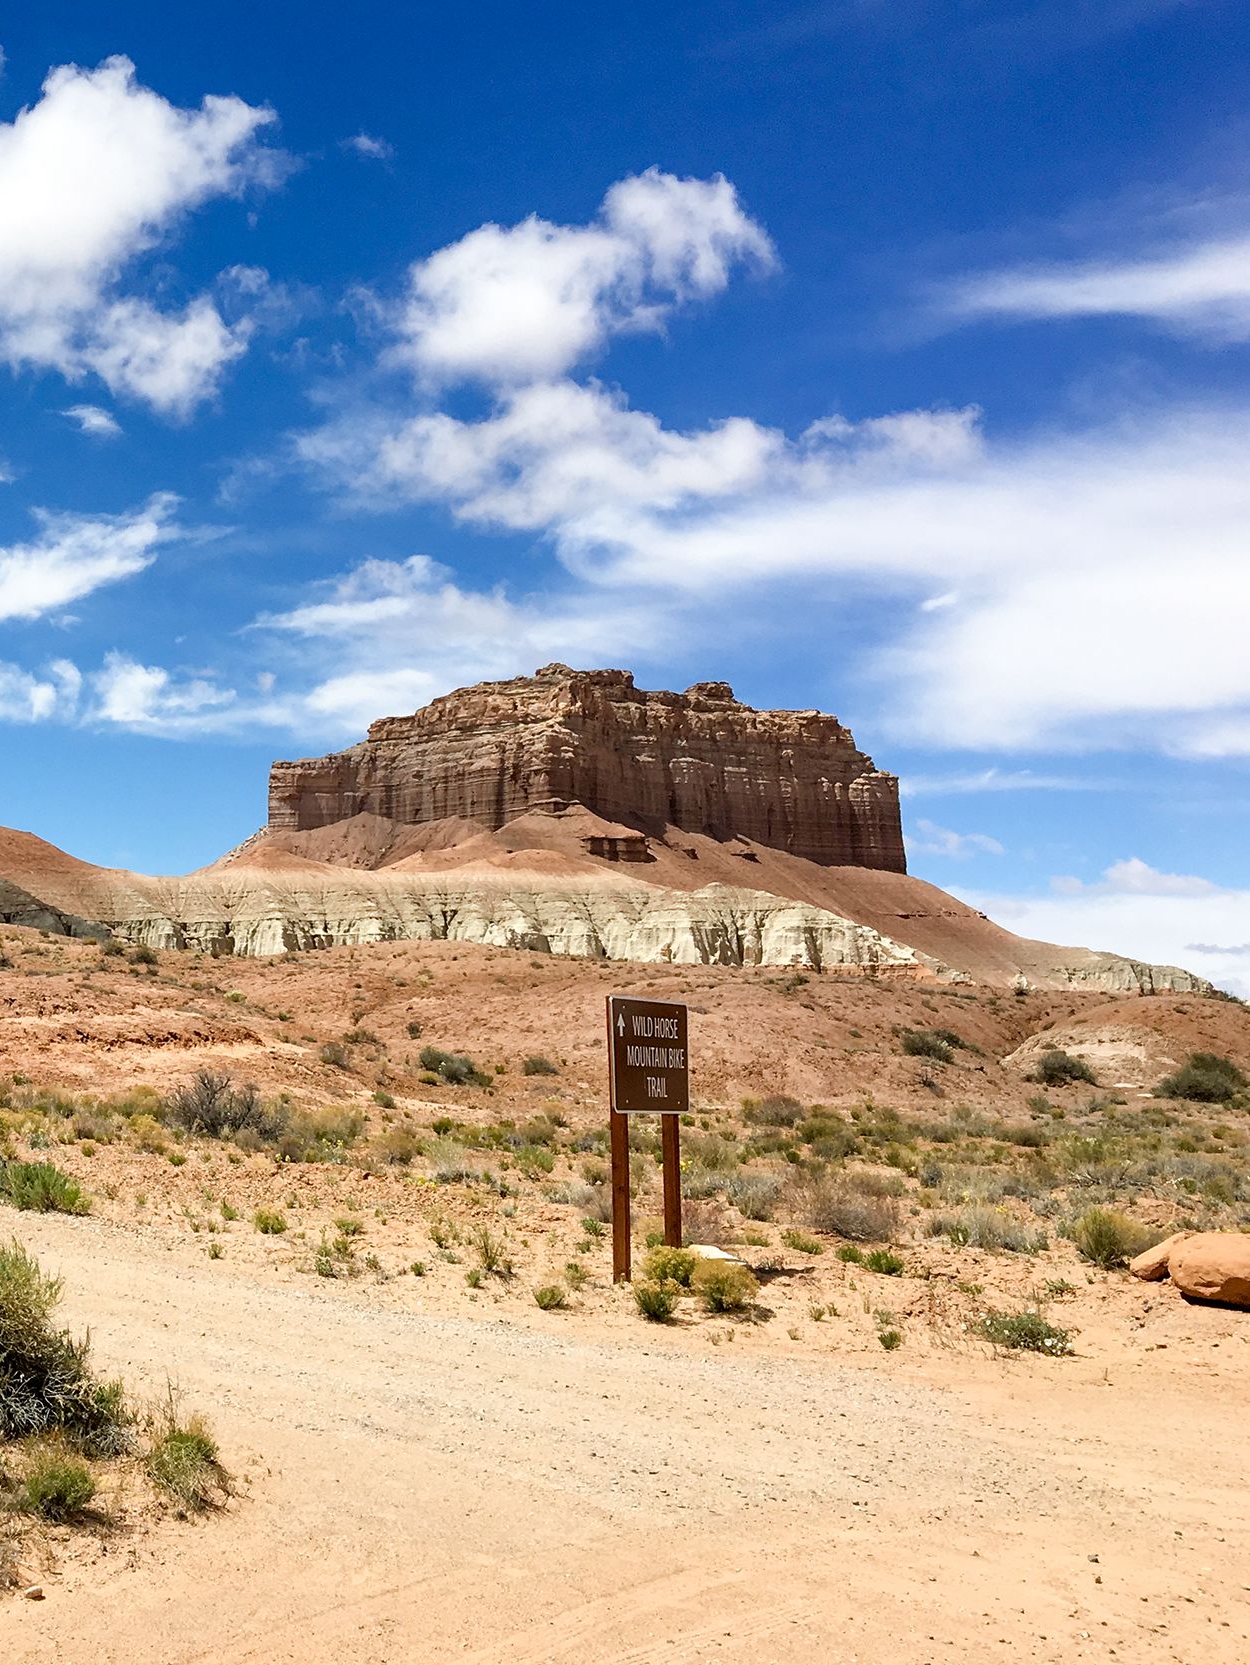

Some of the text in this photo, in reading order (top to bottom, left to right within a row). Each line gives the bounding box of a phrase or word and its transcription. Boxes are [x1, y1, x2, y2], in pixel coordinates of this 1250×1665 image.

[632, 1015, 678, 1038] WILD HORSE
[627, 1045, 685, 1069] MOUNTAIN BIKE
[646, 1076, 668, 1098] TRAIL
